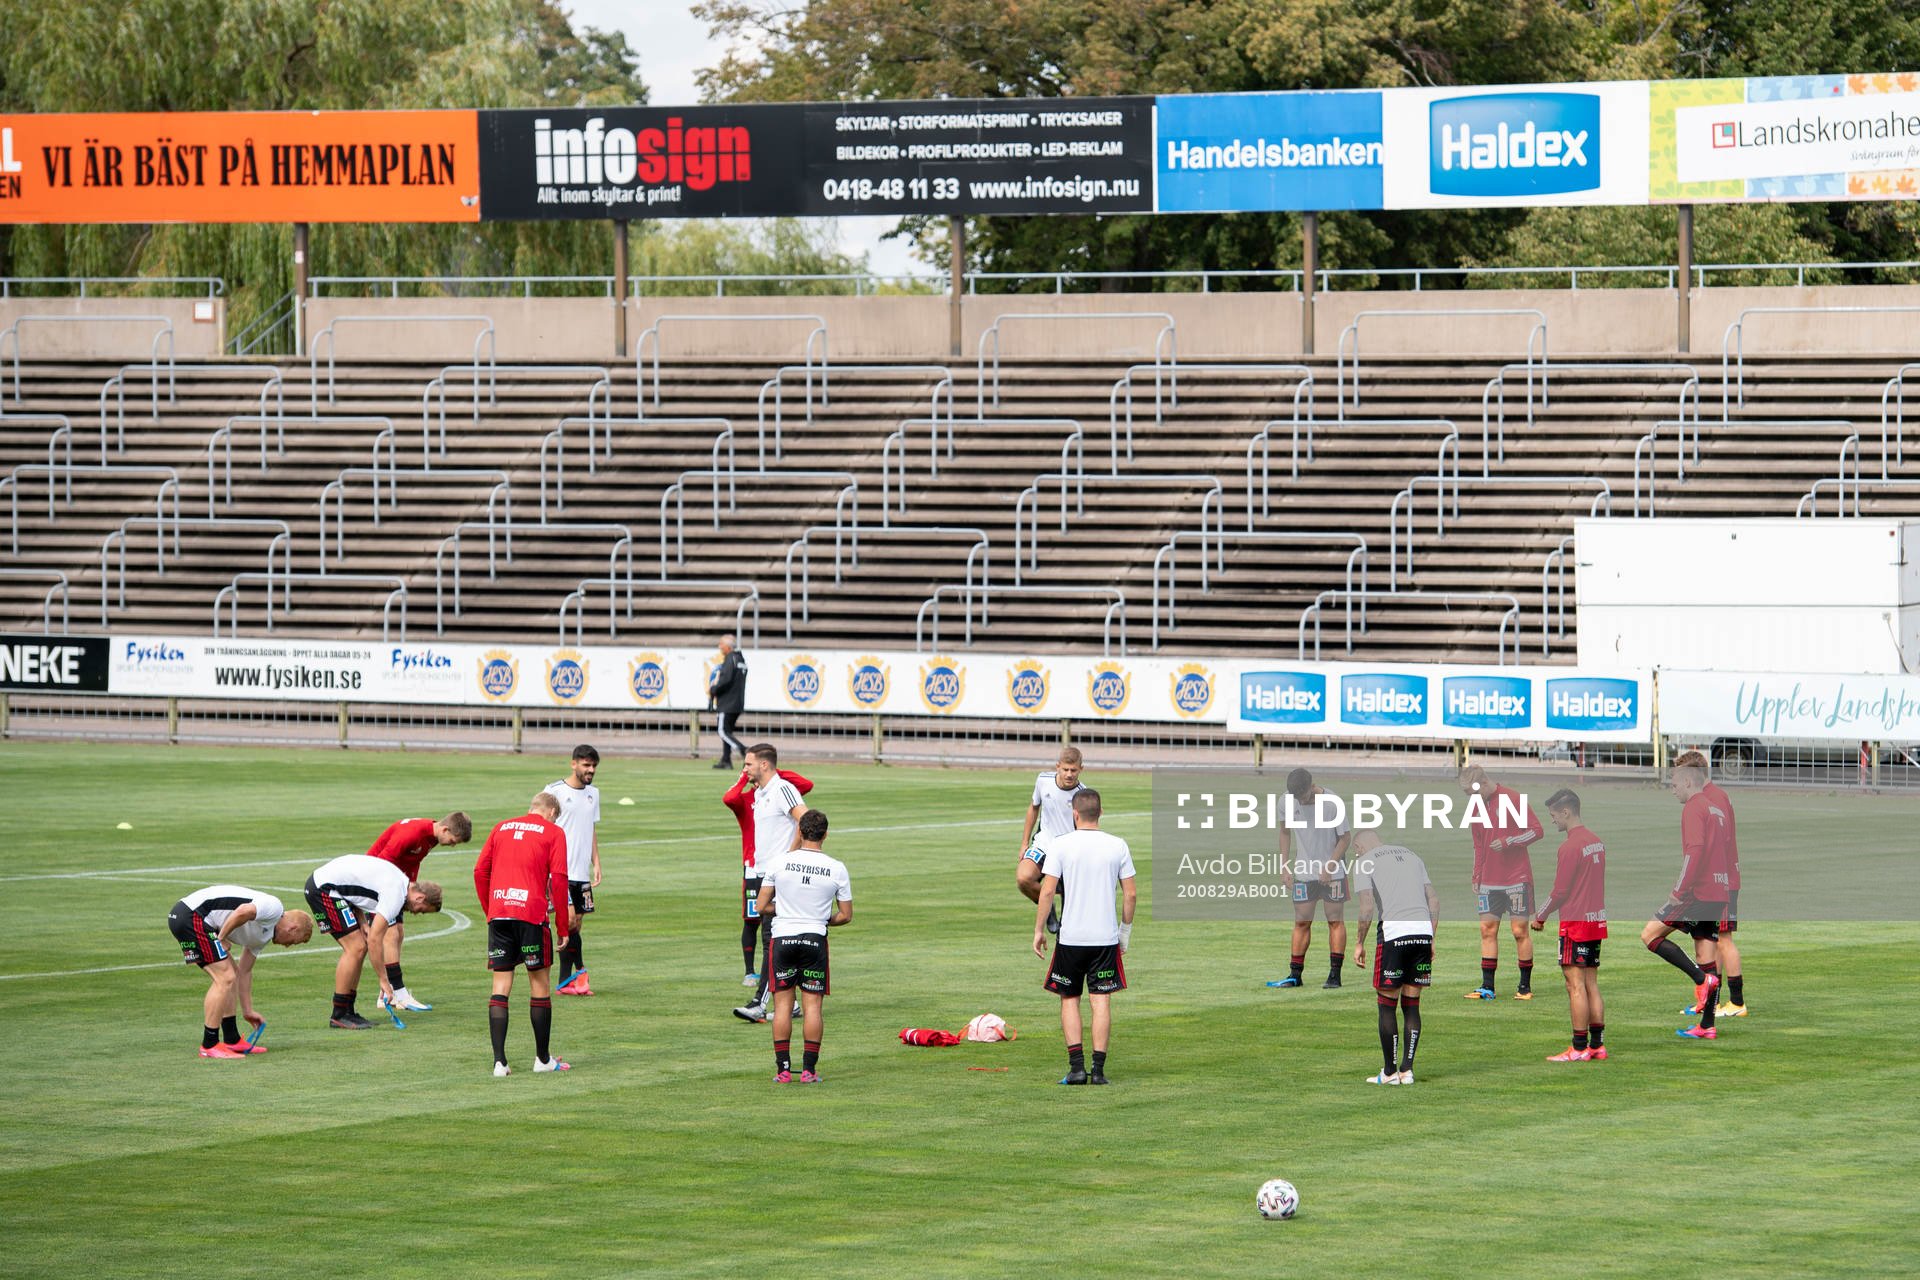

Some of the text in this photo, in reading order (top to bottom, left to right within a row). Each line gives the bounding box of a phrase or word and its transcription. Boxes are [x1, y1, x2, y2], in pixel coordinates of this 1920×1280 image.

[835, 111, 1122, 131] SKYLTAR STORFORMATSPRINT TRYCKSAKER
[534, 117, 751, 191] infosign
[836, 141, 1122, 160] BILDEKOR PROFILPRODUKTER LED-REKLAM
[1168, 136, 1383, 169] Handelsbanken
[1442, 120, 1588, 170] Haldex
[42, 137, 455, 188] VI ÄR BÄST PÅ HEMMAPLAN
[537, 185, 681, 206] Allt inom skyltar & print!
[823, 175, 1139, 202] 0418-48 11 33 www.infosign.nu
[126, 642, 184, 664] Fysiken
[392, 648, 451, 671] Fysiken
[216, 665, 361, 689] www.fysiken.se
[1246, 684, 1321, 711] Haldex
[1347, 687, 1422, 714] Haldex
[1449, 689, 1525, 717] Haldex
[1552, 691, 1631, 718] Haldex
[1736, 680, 1825, 733] Upplev
[785, 862, 831, 877] ASSYRISKA
[802, 875, 811, 885] IK
